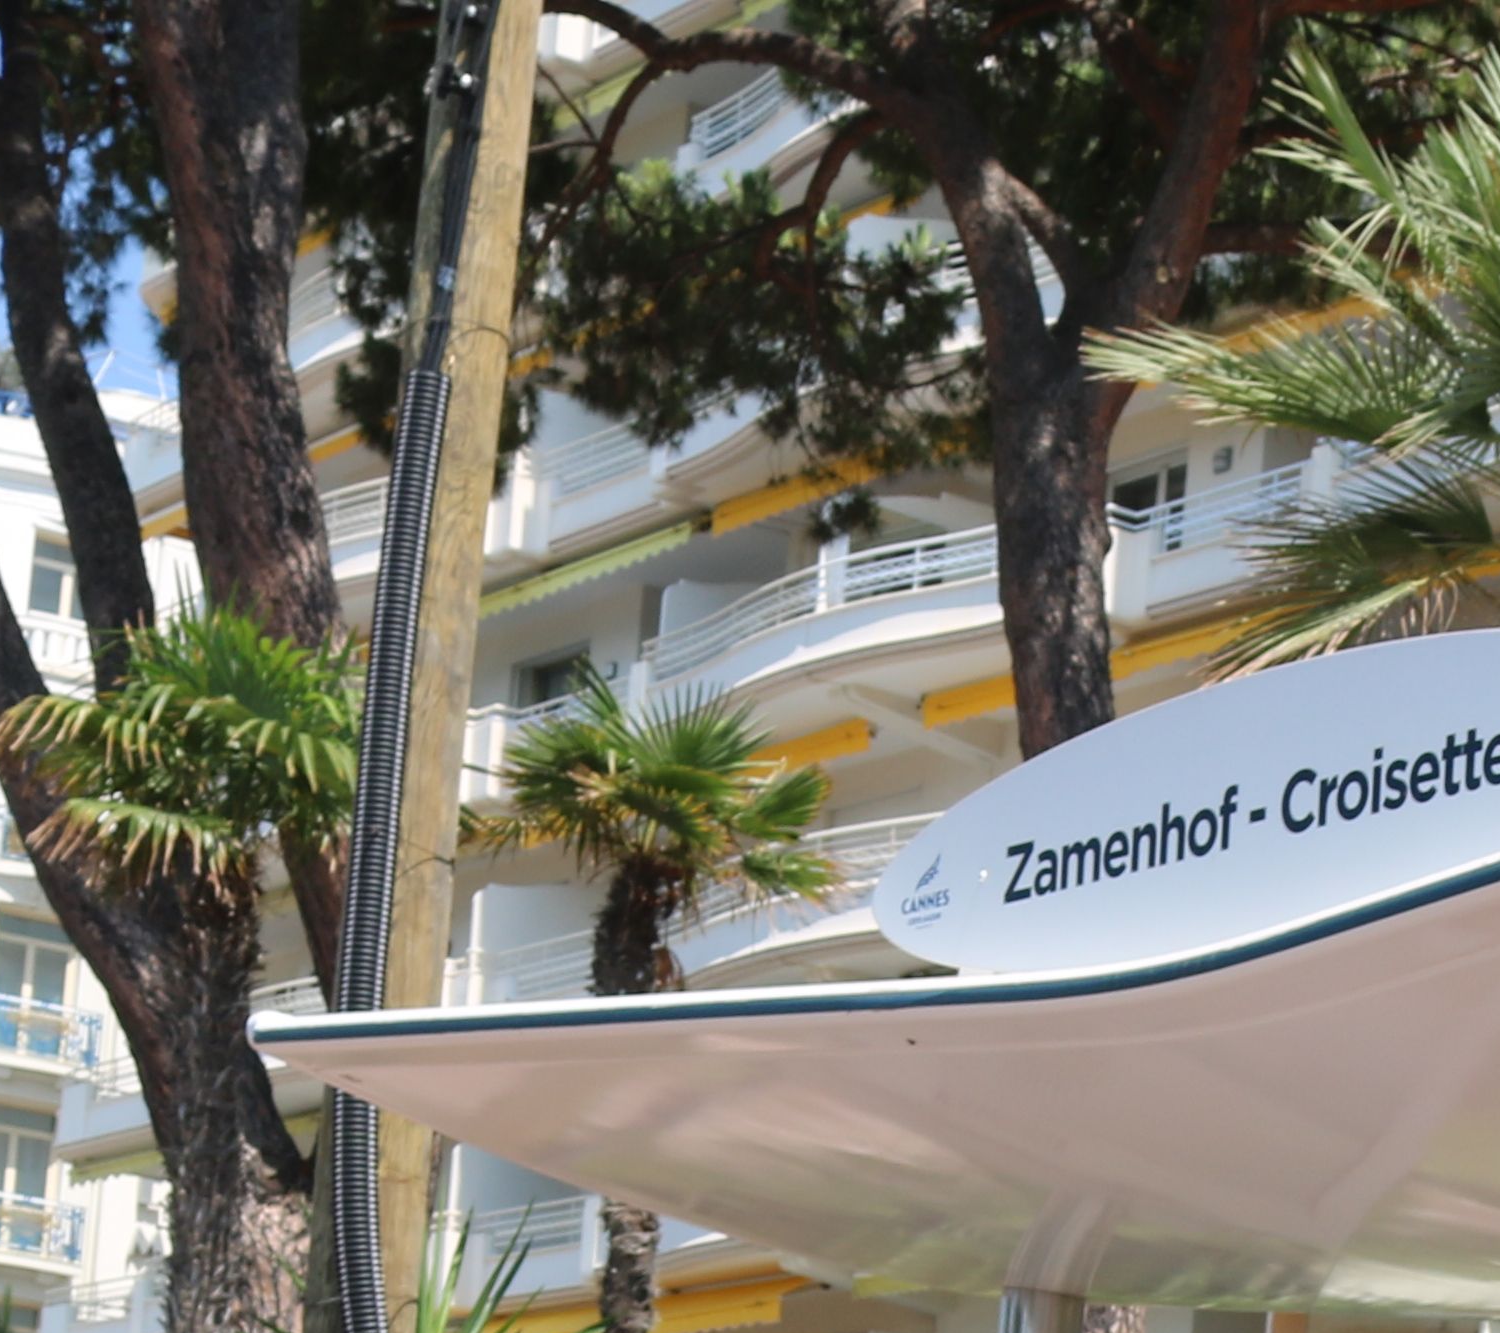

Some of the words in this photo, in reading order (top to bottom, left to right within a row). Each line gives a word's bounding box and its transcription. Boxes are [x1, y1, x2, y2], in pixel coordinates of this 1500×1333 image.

[1003, 786, 1238, 905] Zamenhof
[1249, 807, 1267, 825] -
[901, 888, 950, 915] CANNES
